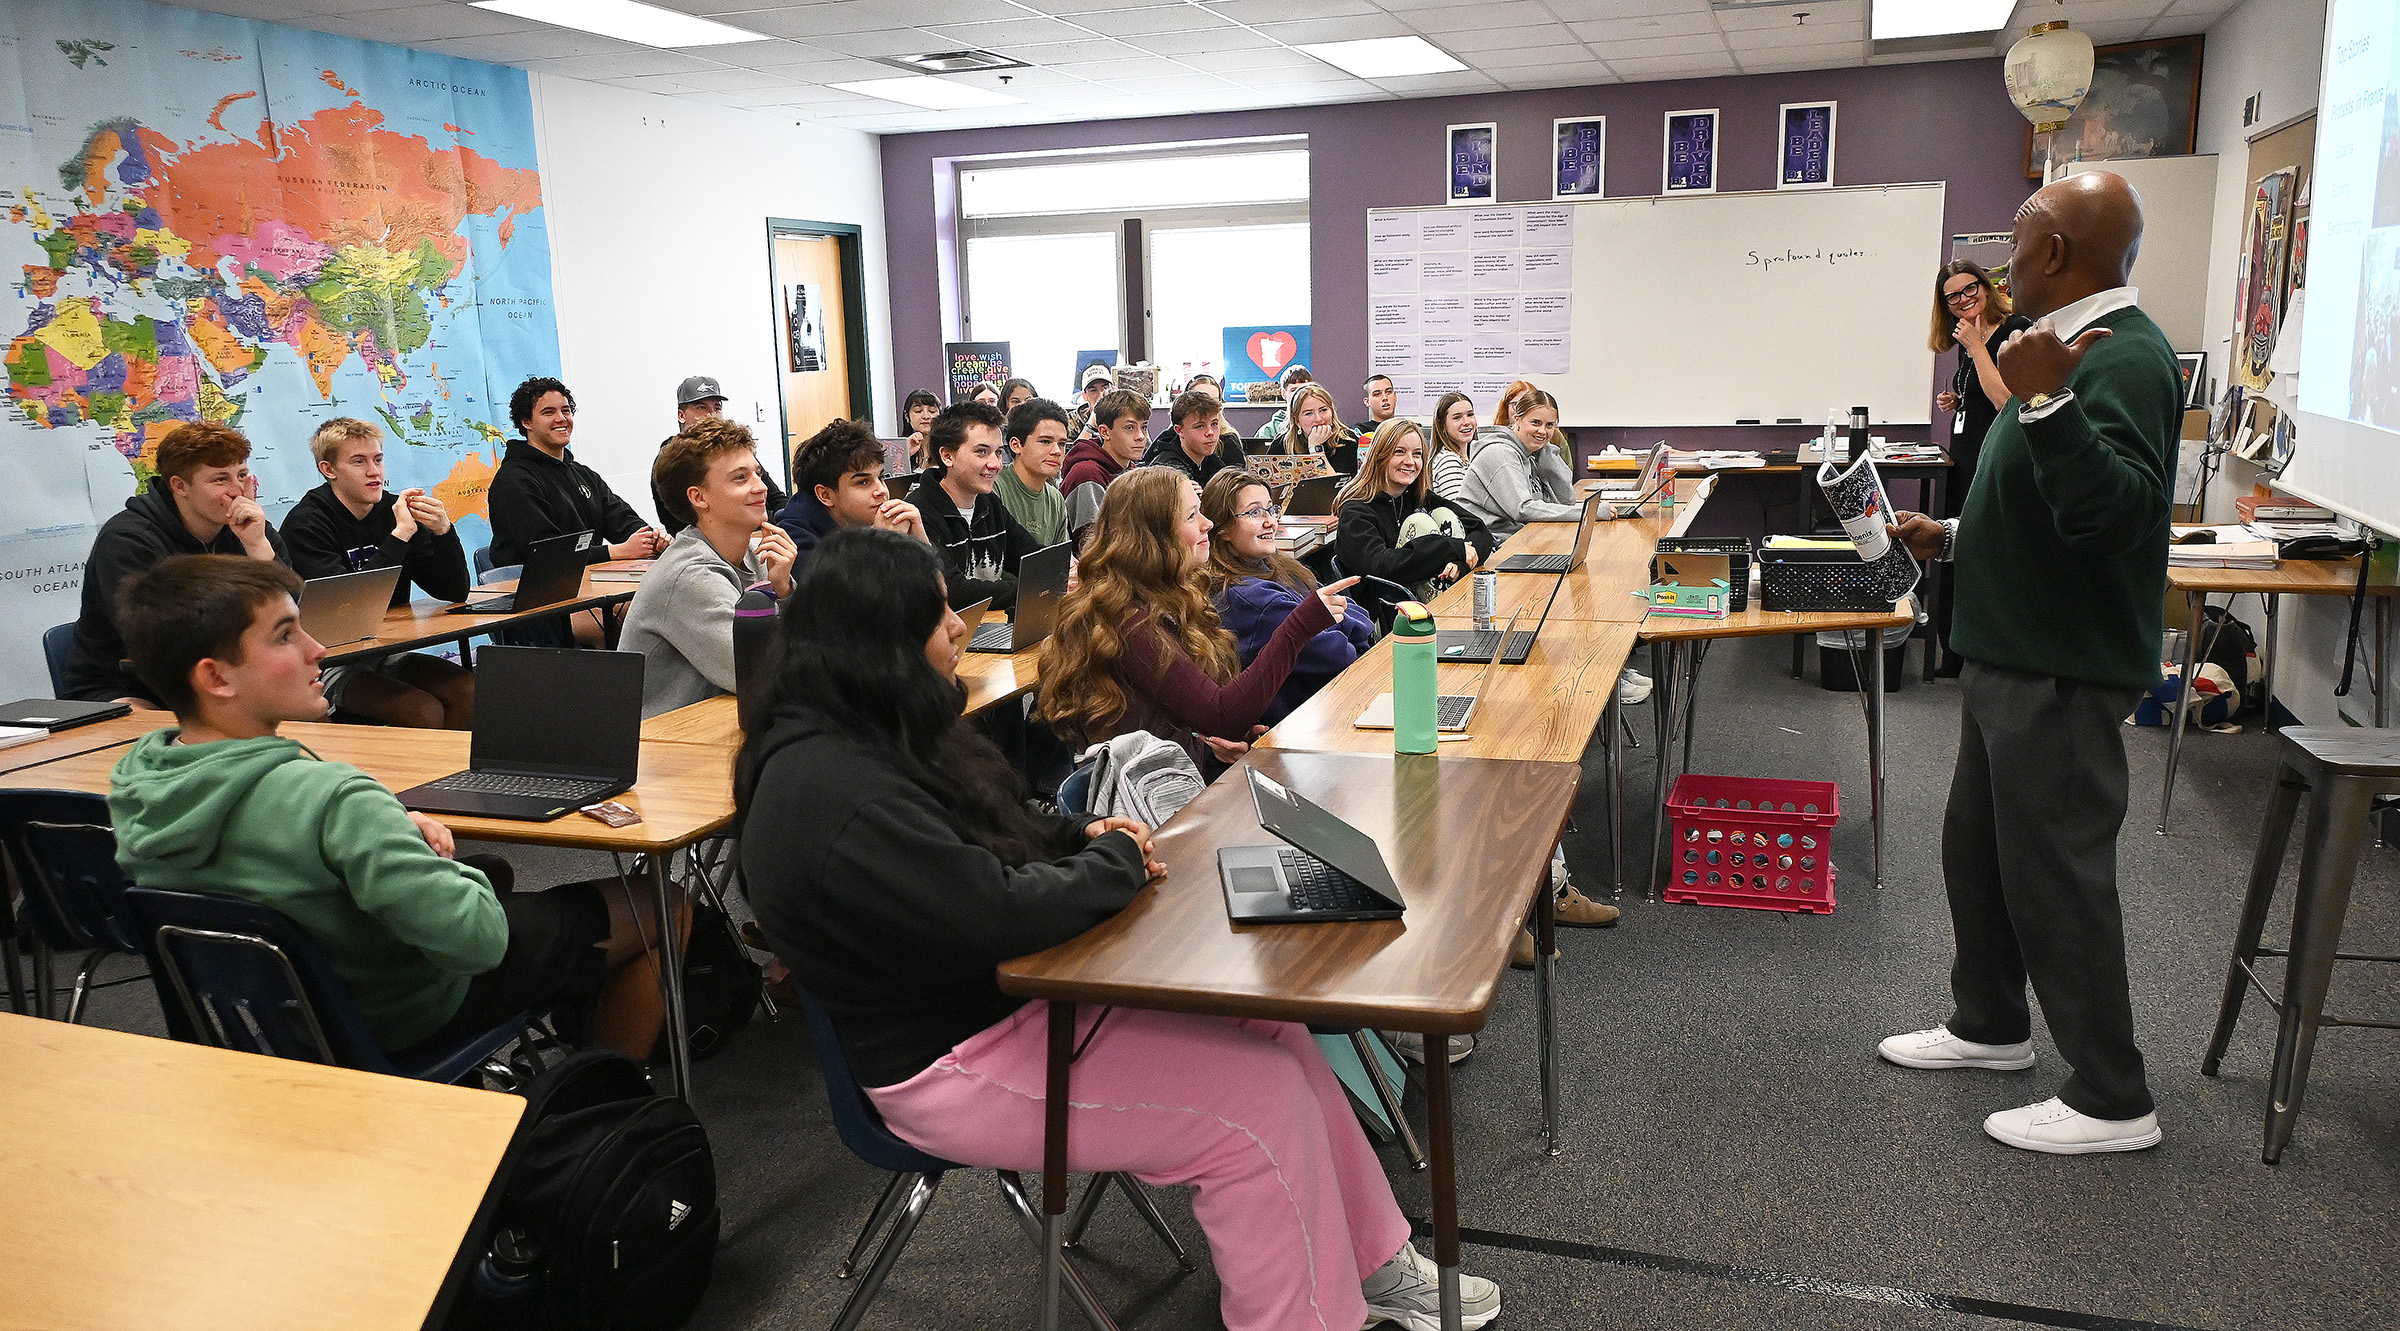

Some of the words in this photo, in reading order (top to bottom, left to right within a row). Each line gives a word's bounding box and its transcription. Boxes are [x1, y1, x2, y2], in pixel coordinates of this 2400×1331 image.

[2348, 33, 2370, 60] Stories
[409, 78, 447, 91] ARCTIC
[452, 84, 487, 97] OCEAN
[2331, 99, 2354, 121] Protests
[2362, 87, 2384, 110] France
[1690, 117, 1710, 186] DRIVEN
[1805, 109, 1824, 181] LEADERS
[1580, 128, 1597, 188] PROUD
[1763, 248, 1821, 272] profound
[490, 298, 516, 306] NORTH
[519, 298, 547, 306] PACIFIC
[507, 311, 533, 319] OCEAN
[0, 567, 42, 581] SOUTH
[33, 580, 79, 594] OCEAN
[1656, 593, 1675, 601] Post-it
[669, 1205, 692, 1231] adidas
